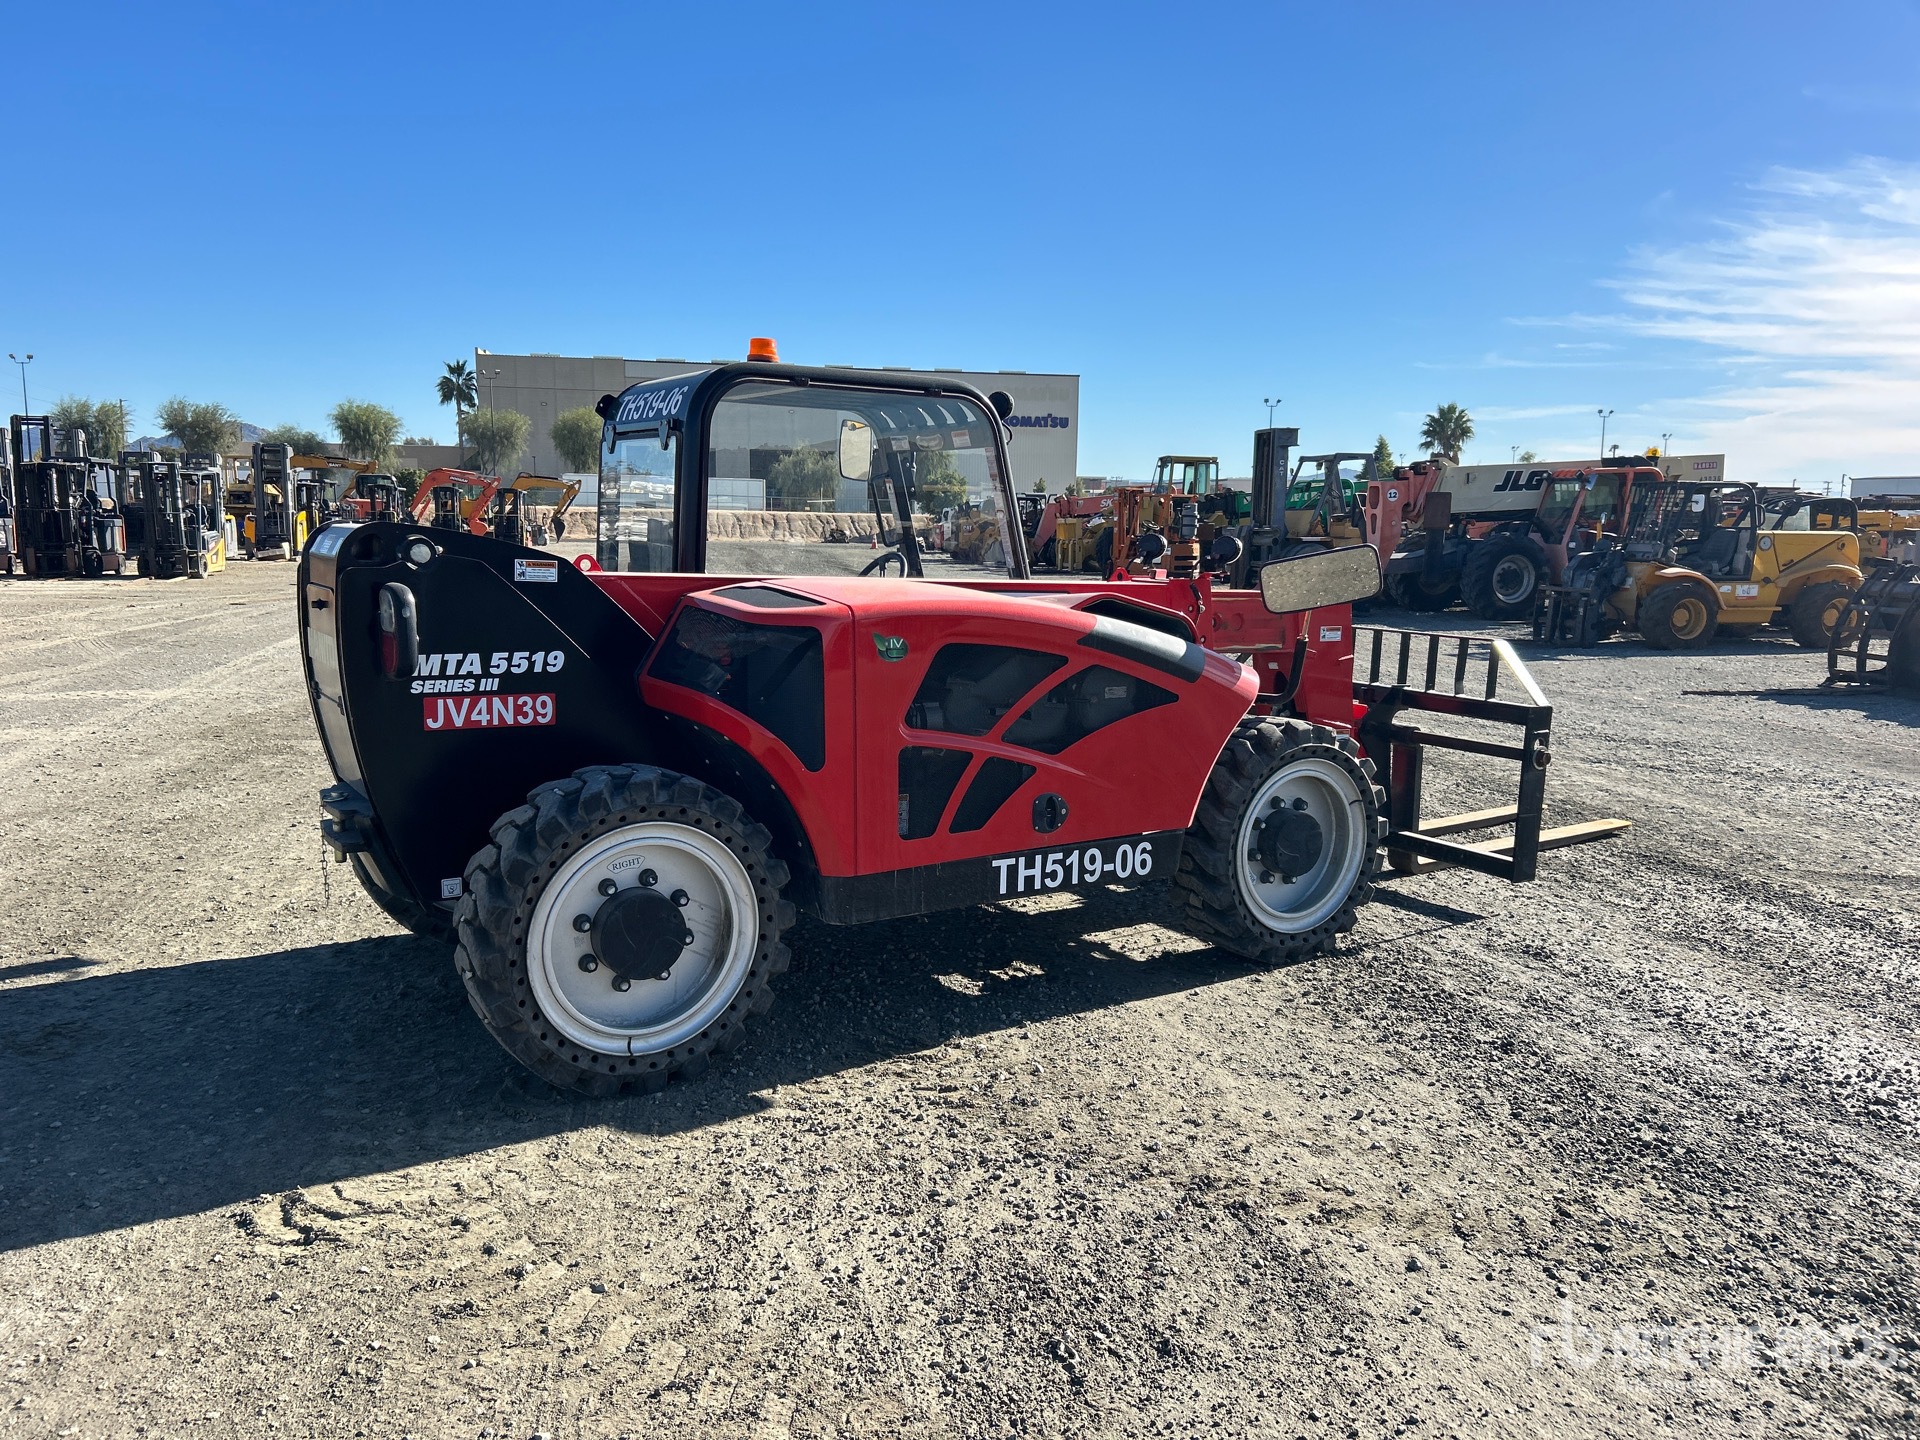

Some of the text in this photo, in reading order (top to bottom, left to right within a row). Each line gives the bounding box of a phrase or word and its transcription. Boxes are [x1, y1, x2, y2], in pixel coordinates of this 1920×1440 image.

[616, 385, 689, 422] TH519-06
[1492, 469, 1549, 492] JLG
[1388, 491, 1398, 499] 12
[412, 650, 565, 676] MTA 5519
[410, 677, 500, 694] SERIES III
[426, 695, 553, 729] JV4N39
[612, 857, 641, 871] RIGHT
[991, 841, 1153, 895] TH519-06
